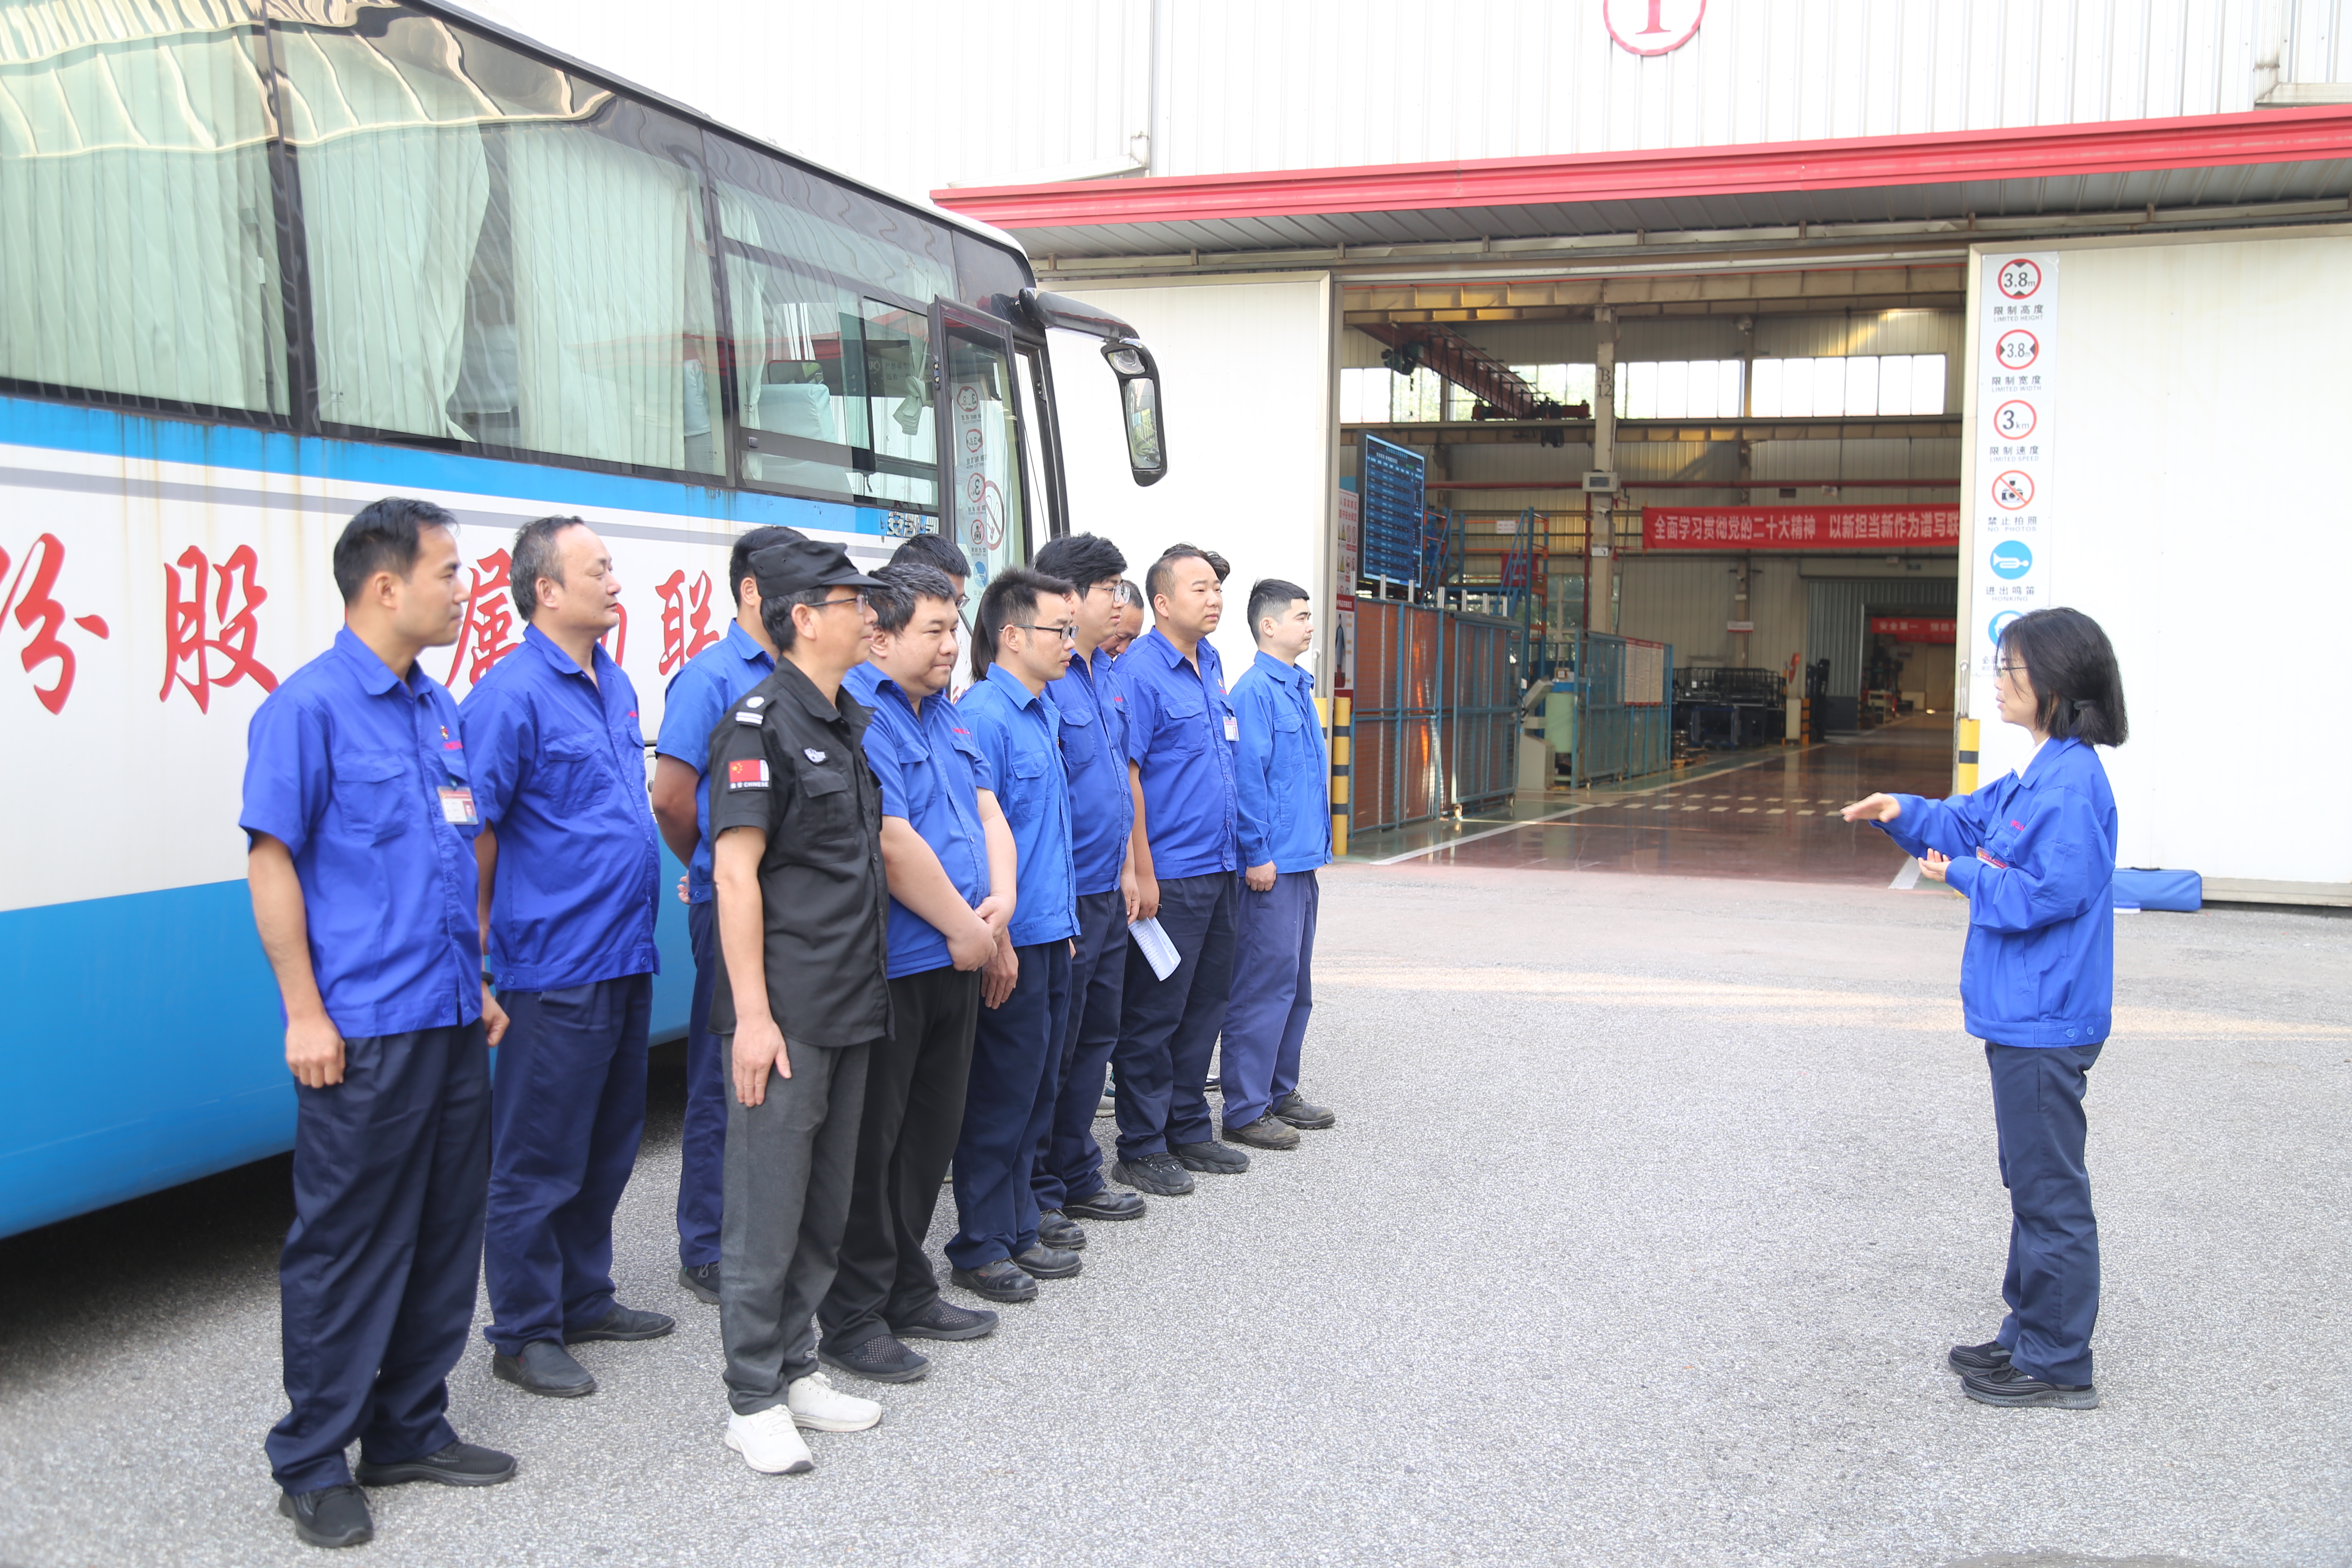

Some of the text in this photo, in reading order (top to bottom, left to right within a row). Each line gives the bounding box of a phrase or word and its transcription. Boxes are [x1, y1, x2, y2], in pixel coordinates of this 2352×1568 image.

[1994, 304, 2043, 315] 限制高度
[1598, 368, 1611, 382] B
[1992, 375, 2041, 386] 限制宽度
[1597, 383, 1612, 397] 12
[1990, 446, 2039, 456] 限制速度
[1654, 511, 1959, 540] 全面学习贯彻党的二十大精神 以新担当新作为谱写联
[1988, 516, 2037, 526] 禁止拍照
[1986, 586, 2035, 595] 进出鸣笛
[1880, 622, 1919, 631] 安全第一
